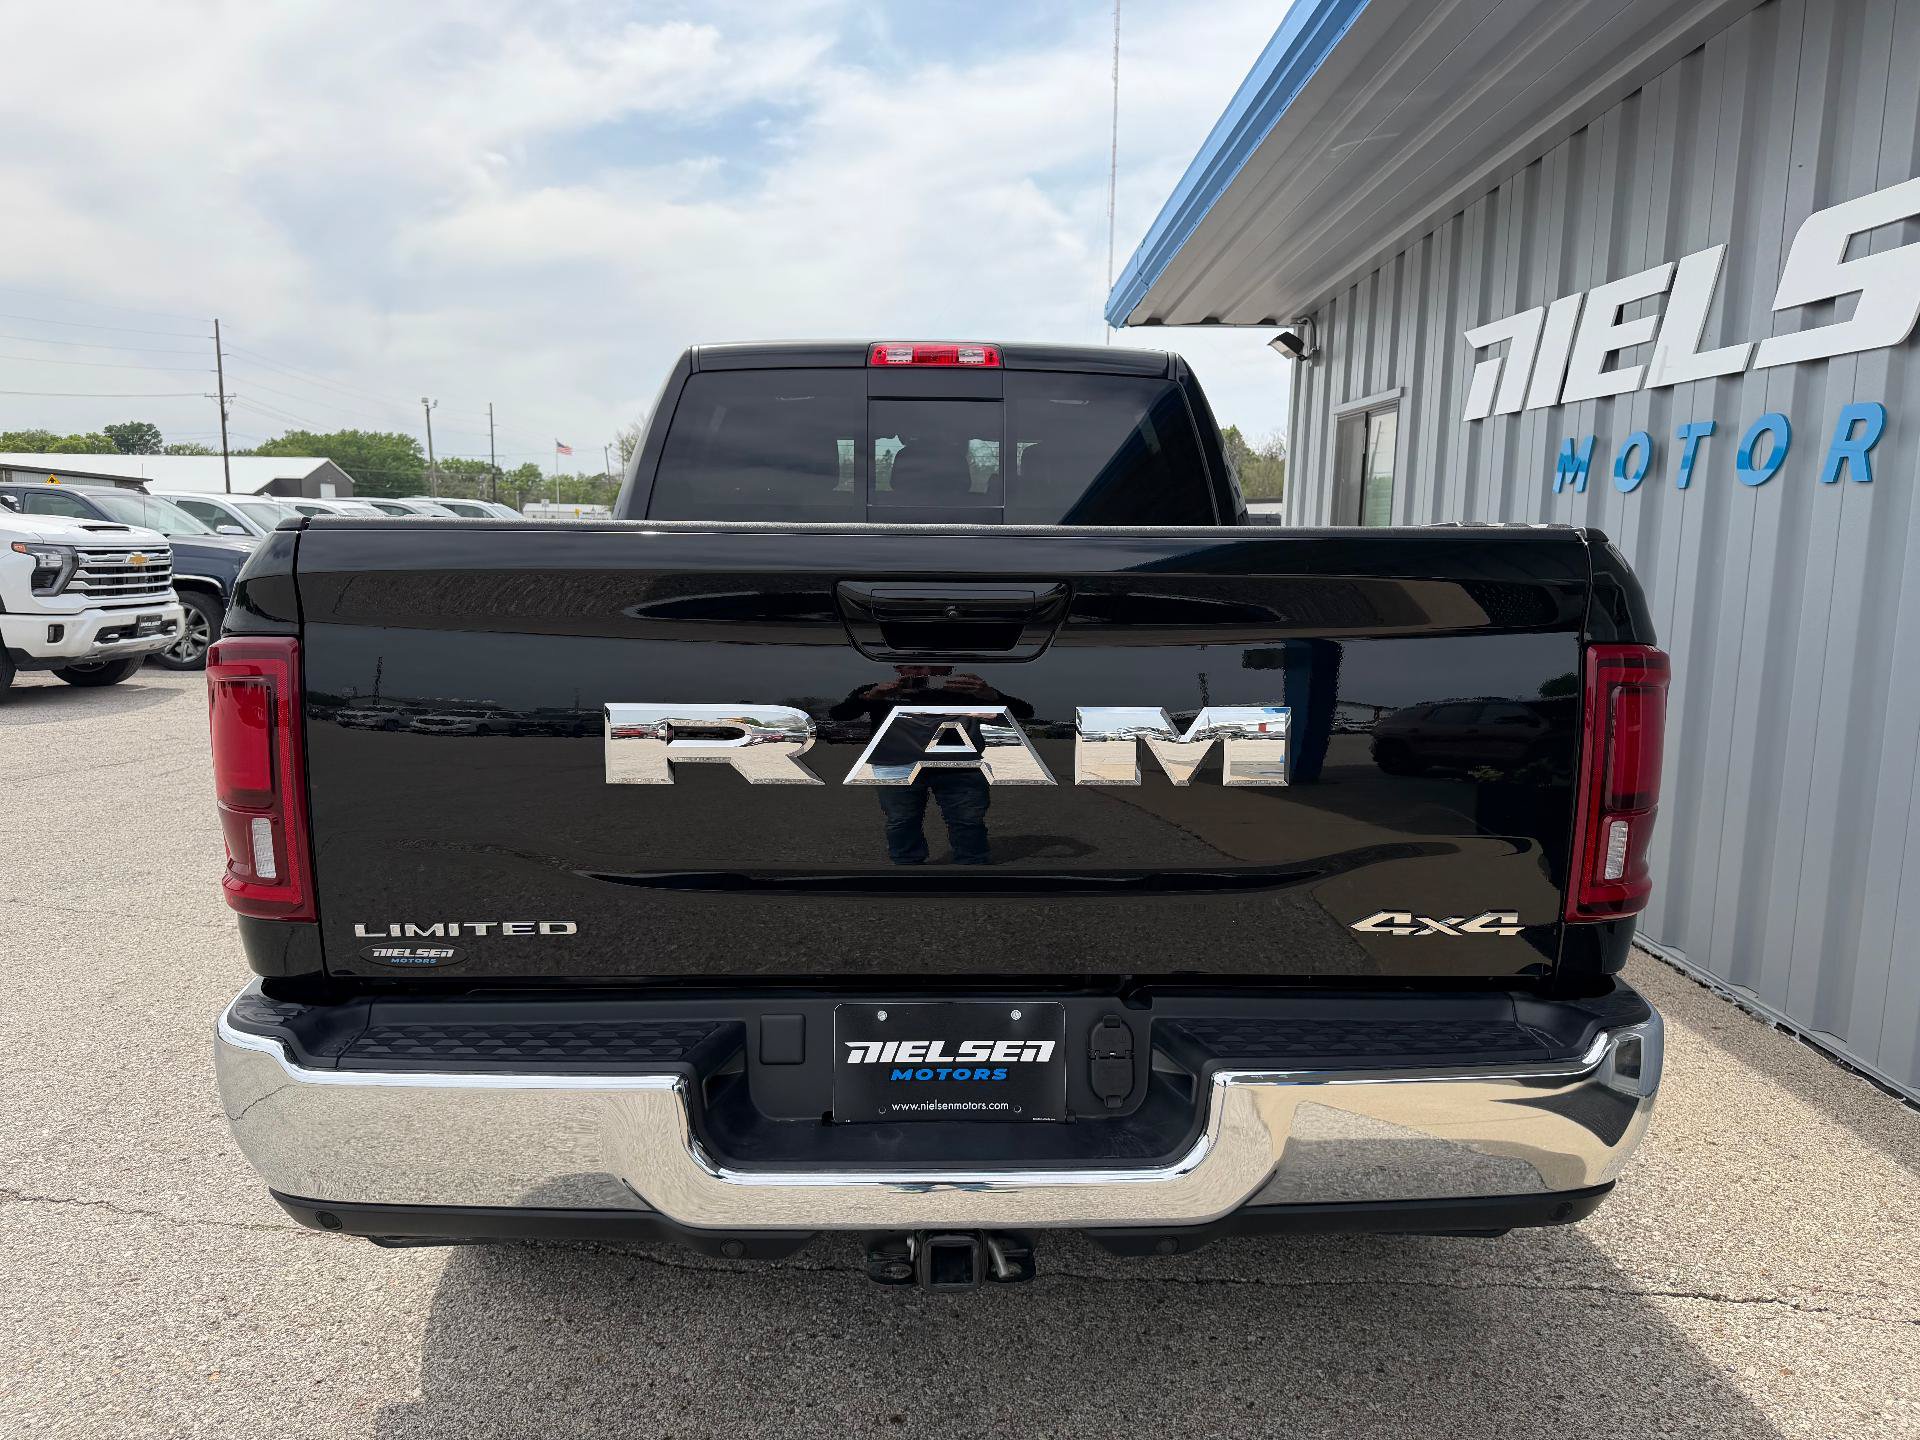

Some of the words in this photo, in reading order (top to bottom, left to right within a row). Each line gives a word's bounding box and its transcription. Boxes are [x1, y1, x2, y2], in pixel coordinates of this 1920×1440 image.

[1463, 176, 1920, 422] NIELS
[1552, 401, 1888, 494] MOTOR
[604, 702, 1292, 786] RAM
[353, 920, 578, 938] LIMITED
[372, 948, 455, 958] NIELSEN
[844, 1040, 1056, 1064] NIELSEN
[890, 1068, 1008, 1081] MOTORS
[891, 1100, 1009, 1111] www.nielsenmotors.com
